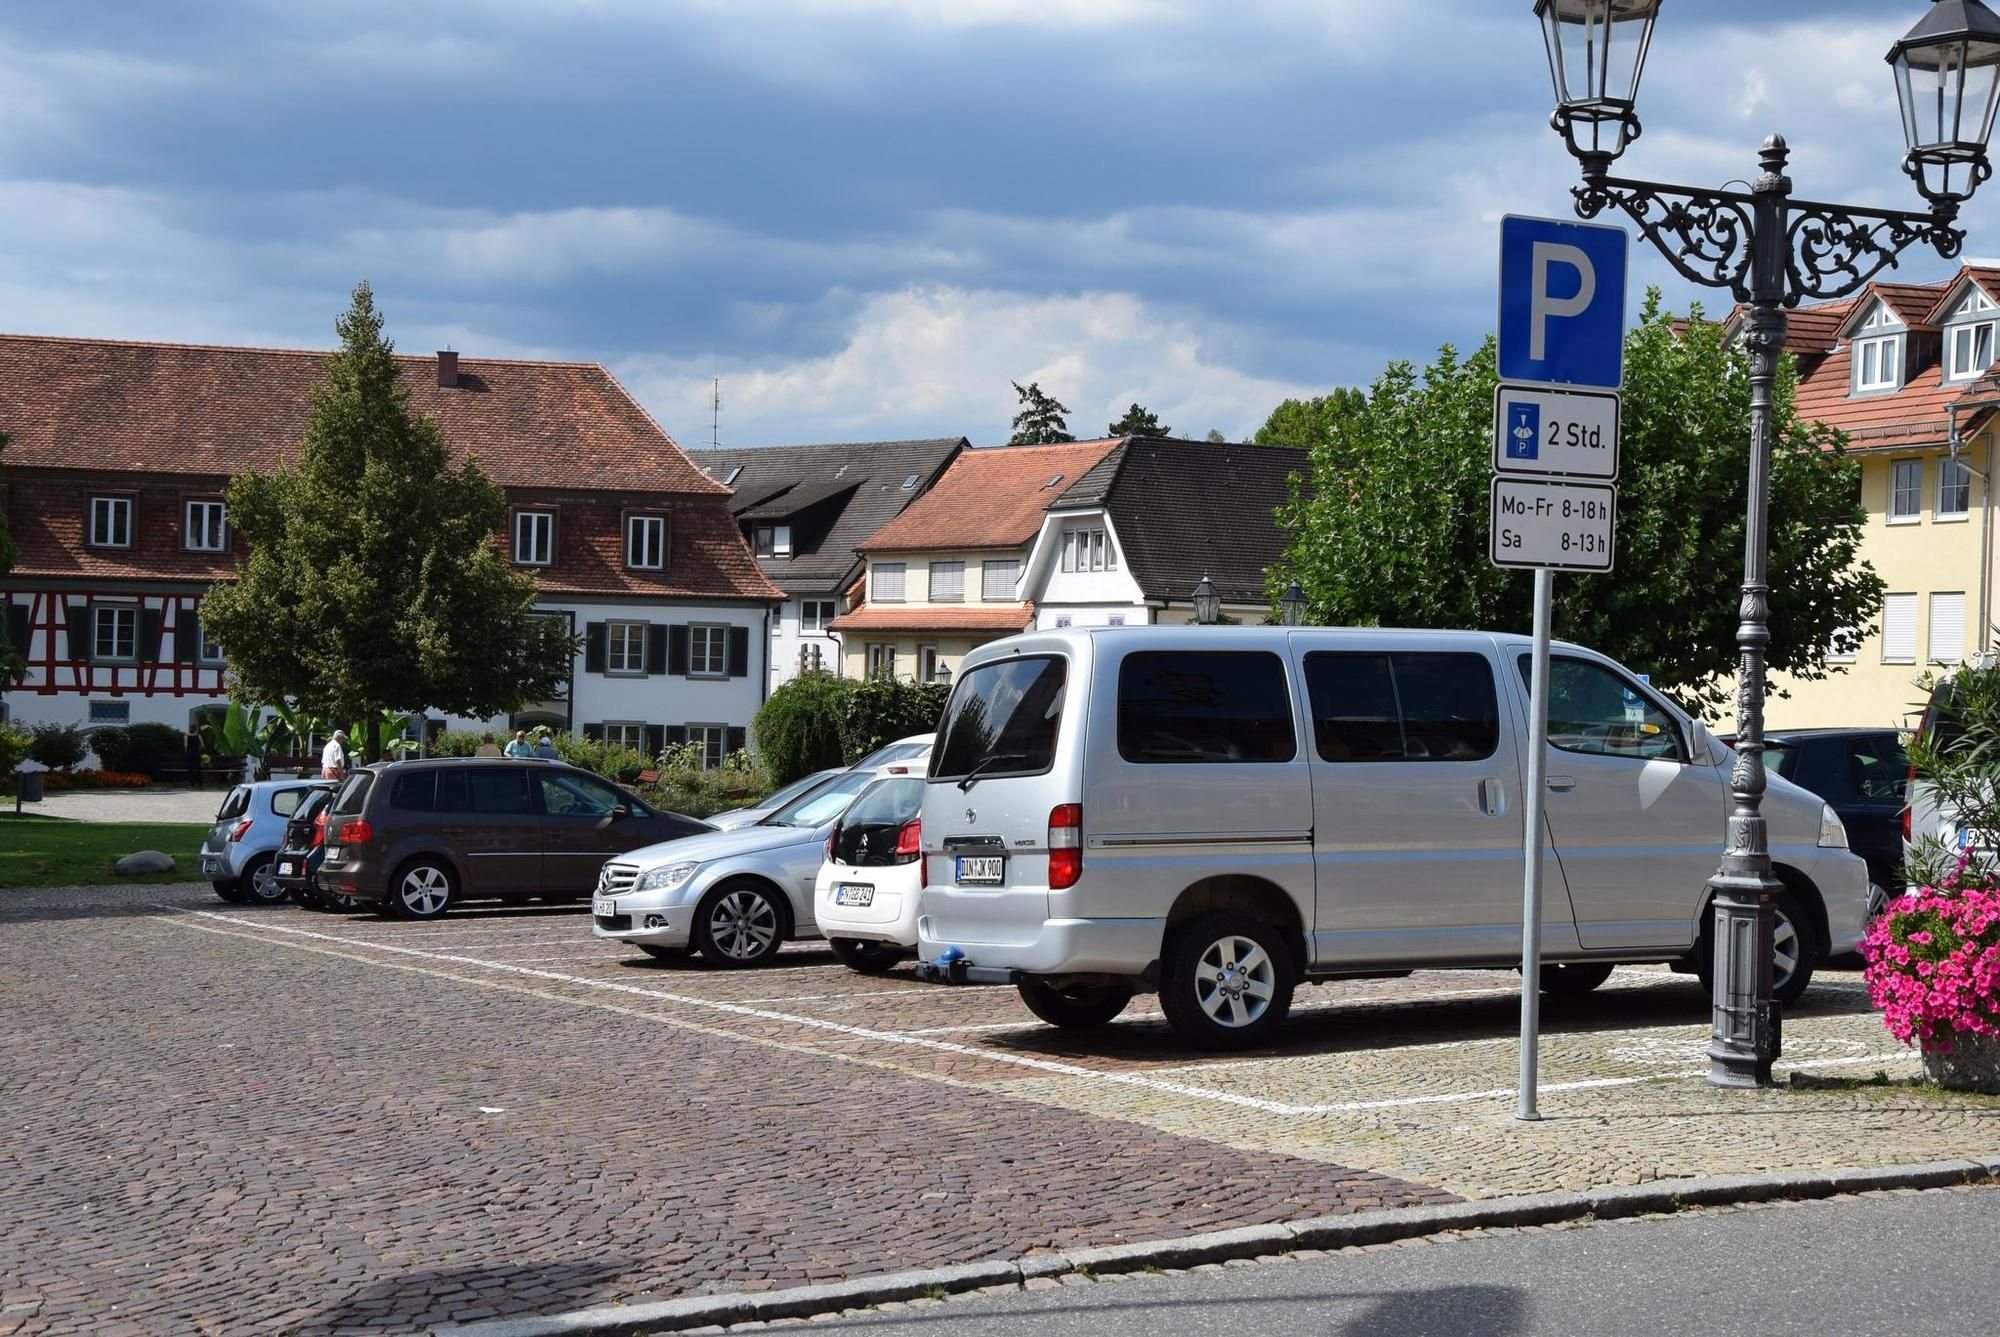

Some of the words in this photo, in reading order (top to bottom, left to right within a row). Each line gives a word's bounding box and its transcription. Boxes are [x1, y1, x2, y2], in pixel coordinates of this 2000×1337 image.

[1529, 240, 1596, 361] P
[1548, 421, 1560, 446] 2
[1566, 422, 1605, 449] Std.
[1519, 441, 1527, 454] P
[1502, 496, 1554, 517] Mo-Fr
[1562, 499, 1596, 520] 8-18
[1600, 502, 1606, 520] h
[1502, 529, 1521, 548] Sa
[1561, 532, 1594, 552] 8-13
[1598, 535, 1605, 553] h
[961, 859, 974, 877] DIN
[978, 859, 987, 877] JK
[988, 859, 1001, 877] 900
[859, 888, 872, 901] 241
